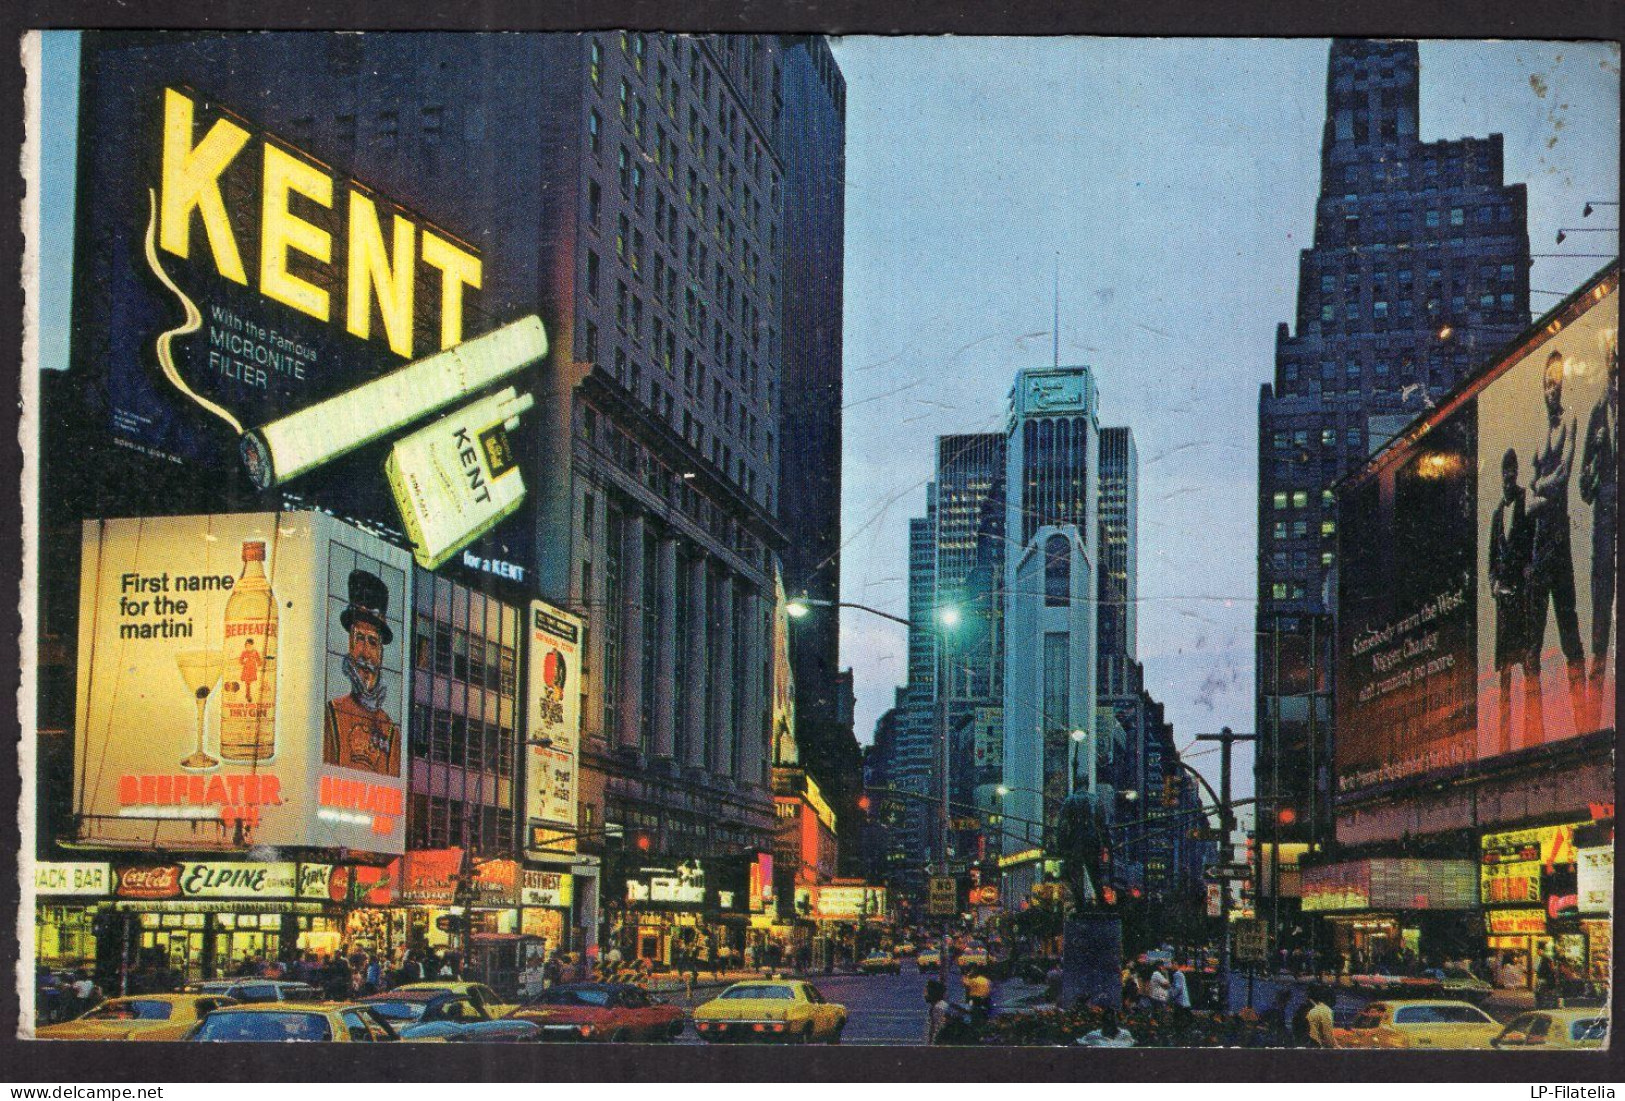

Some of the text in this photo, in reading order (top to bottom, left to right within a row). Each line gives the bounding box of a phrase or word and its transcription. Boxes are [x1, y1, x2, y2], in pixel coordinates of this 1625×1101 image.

[160, 86, 483, 361] KENT
[211, 304, 318, 362] With the Famous
[210, 325, 306, 381] MICRONITE
[209, 350, 268, 390] FILTER
[452, 427, 491, 504] KENT
[121, 573, 234, 593] First name
[492, 558, 524, 582] KENT
[120, 597, 188, 616] for the
[120, 619, 193, 639] martini
[74, 868, 102, 888] BAR
[183, 865, 268, 893] ELPINE
